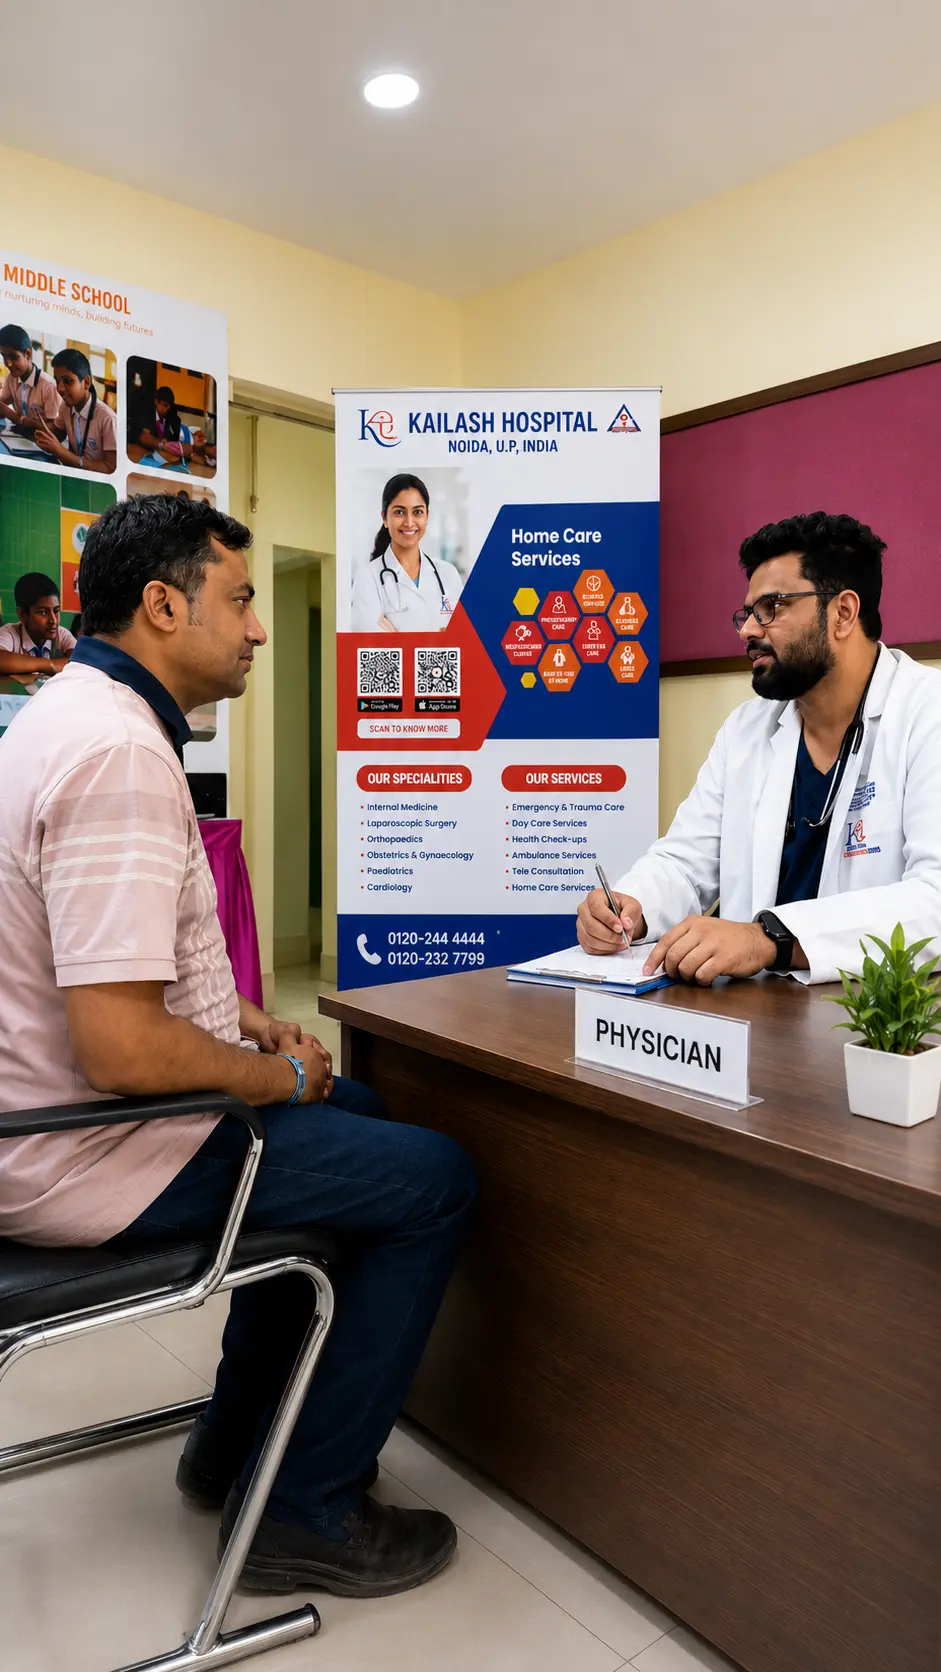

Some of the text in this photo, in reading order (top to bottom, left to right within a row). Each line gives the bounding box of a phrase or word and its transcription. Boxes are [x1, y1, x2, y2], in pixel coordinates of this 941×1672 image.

[4, 264, 130, 314] MIDDLE SCHOOL
[5, 291, 154, 336] nurturing minds, building futures
[409, 412, 597, 433] KAILASH HOSPITAL
[449, 440, 558, 454] NOIDA, U.P, INDIA
[512, 528, 601, 543] Home Care
[512, 550, 580, 566] Services
[368, 773, 462, 784] OUR SPECIALITIES
[526, 773, 602, 784] OUR SERVICES
[367, 803, 438, 812] Internal Medicine
[512, 803, 625, 813] Emergency & Trauma Care
[367, 818, 457, 829] Laparoscopic Surgery
[512, 819, 588, 829] Day Care Services
[367, 834, 423, 845] Orthopaedics
[512, 835, 588, 845] Health Check-ups
[367, 850, 474, 861] Obstetrics & Gynaecology
[512, 850, 597, 860] Ambulance Services
[367, 866, 414, 876] Paediatrics
[512, 867, 584, 876] Tele Consultation
[367, 882, 413, 893] Cardiology
[512, 883, 596, 892] Home Care Services
[388, 932, 485, 946] 0120-244 4444
[388, 952, 485, 966] 0120-232 7799
[595, 1017, 722, 1073] PHYSICIAN
